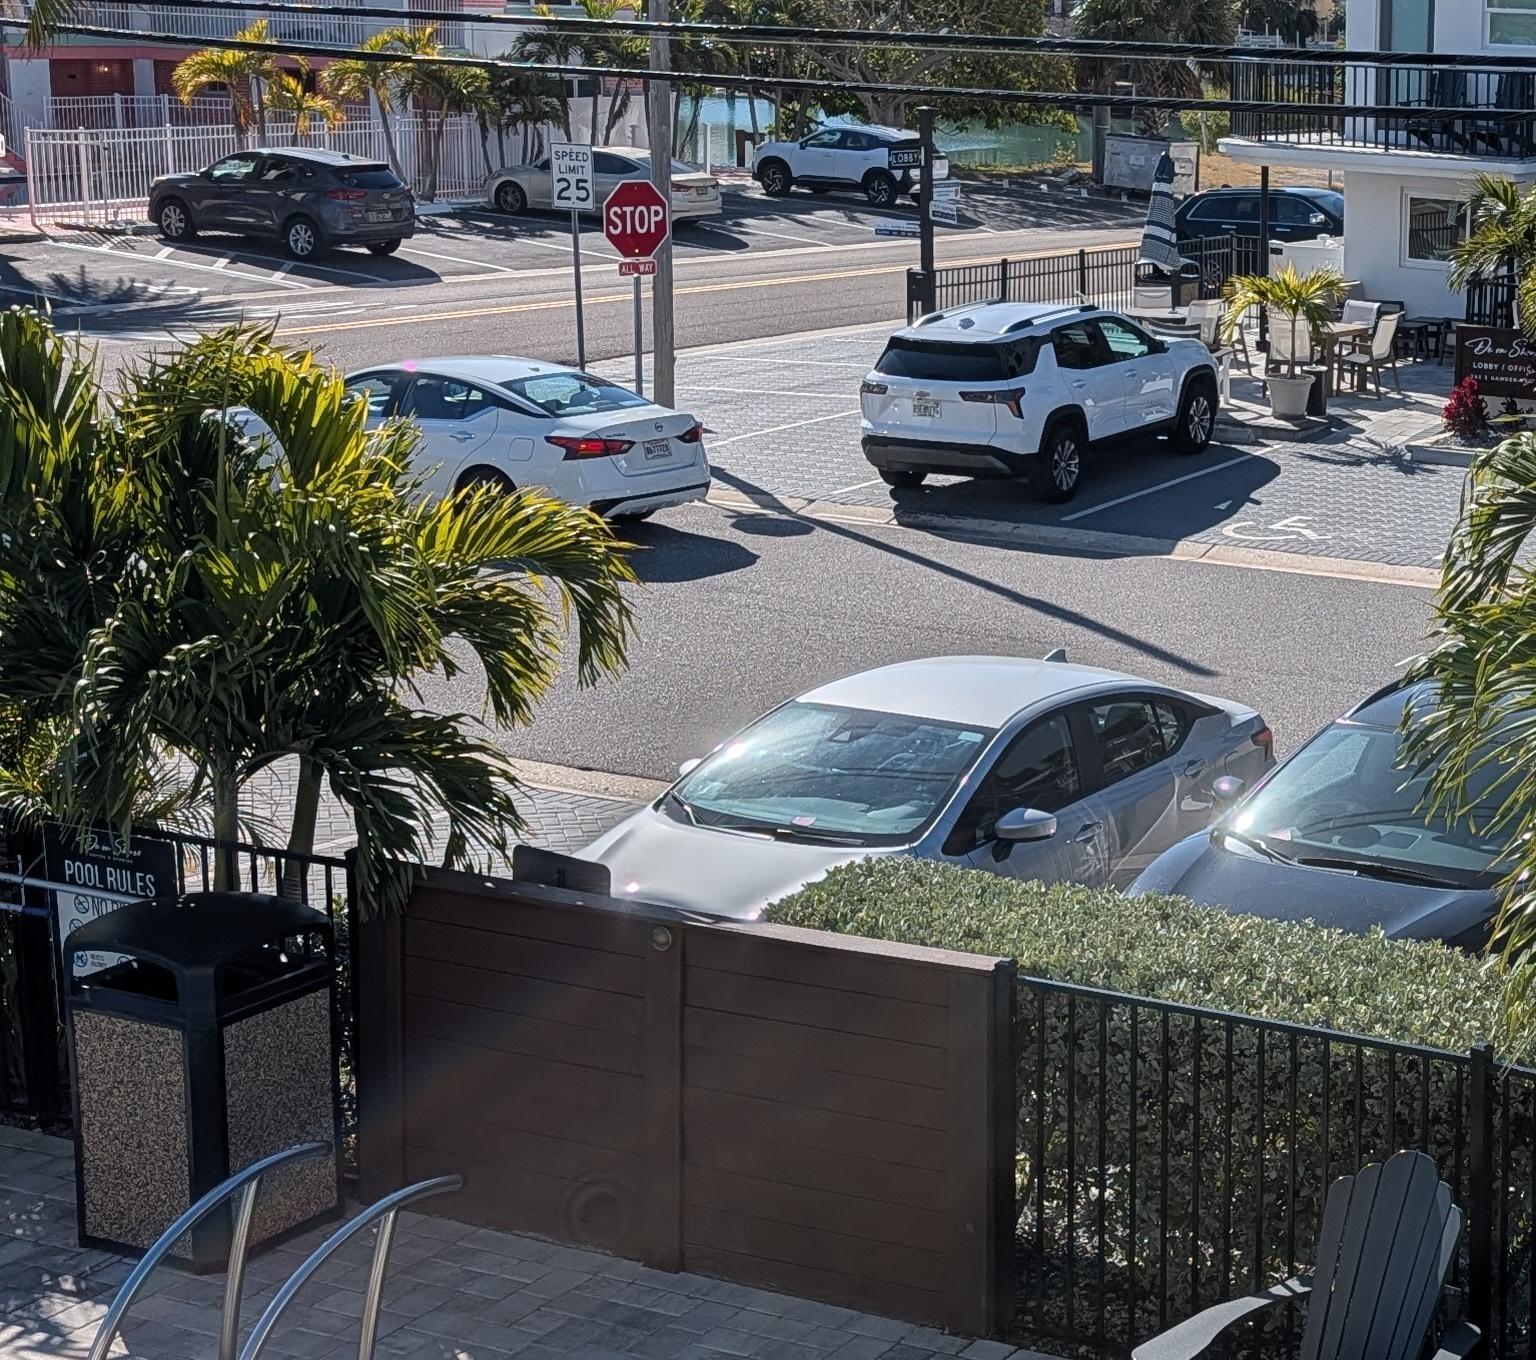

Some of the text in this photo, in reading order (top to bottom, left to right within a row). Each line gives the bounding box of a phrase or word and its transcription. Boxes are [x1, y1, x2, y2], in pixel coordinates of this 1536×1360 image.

[554, 150, 589, 161] SPEED
[892, 153, 918, 163] LOBBY
[558, 164, 586, 175] LIMIT
[556, 177, 590, 202] 25
[608, 205, 664, 235] STOP
[621, 263, 654, 274] ALL WAY
[1472, 362, 1499, 370] LOBBY
[64, 859, 156, 898] POOL RULES
